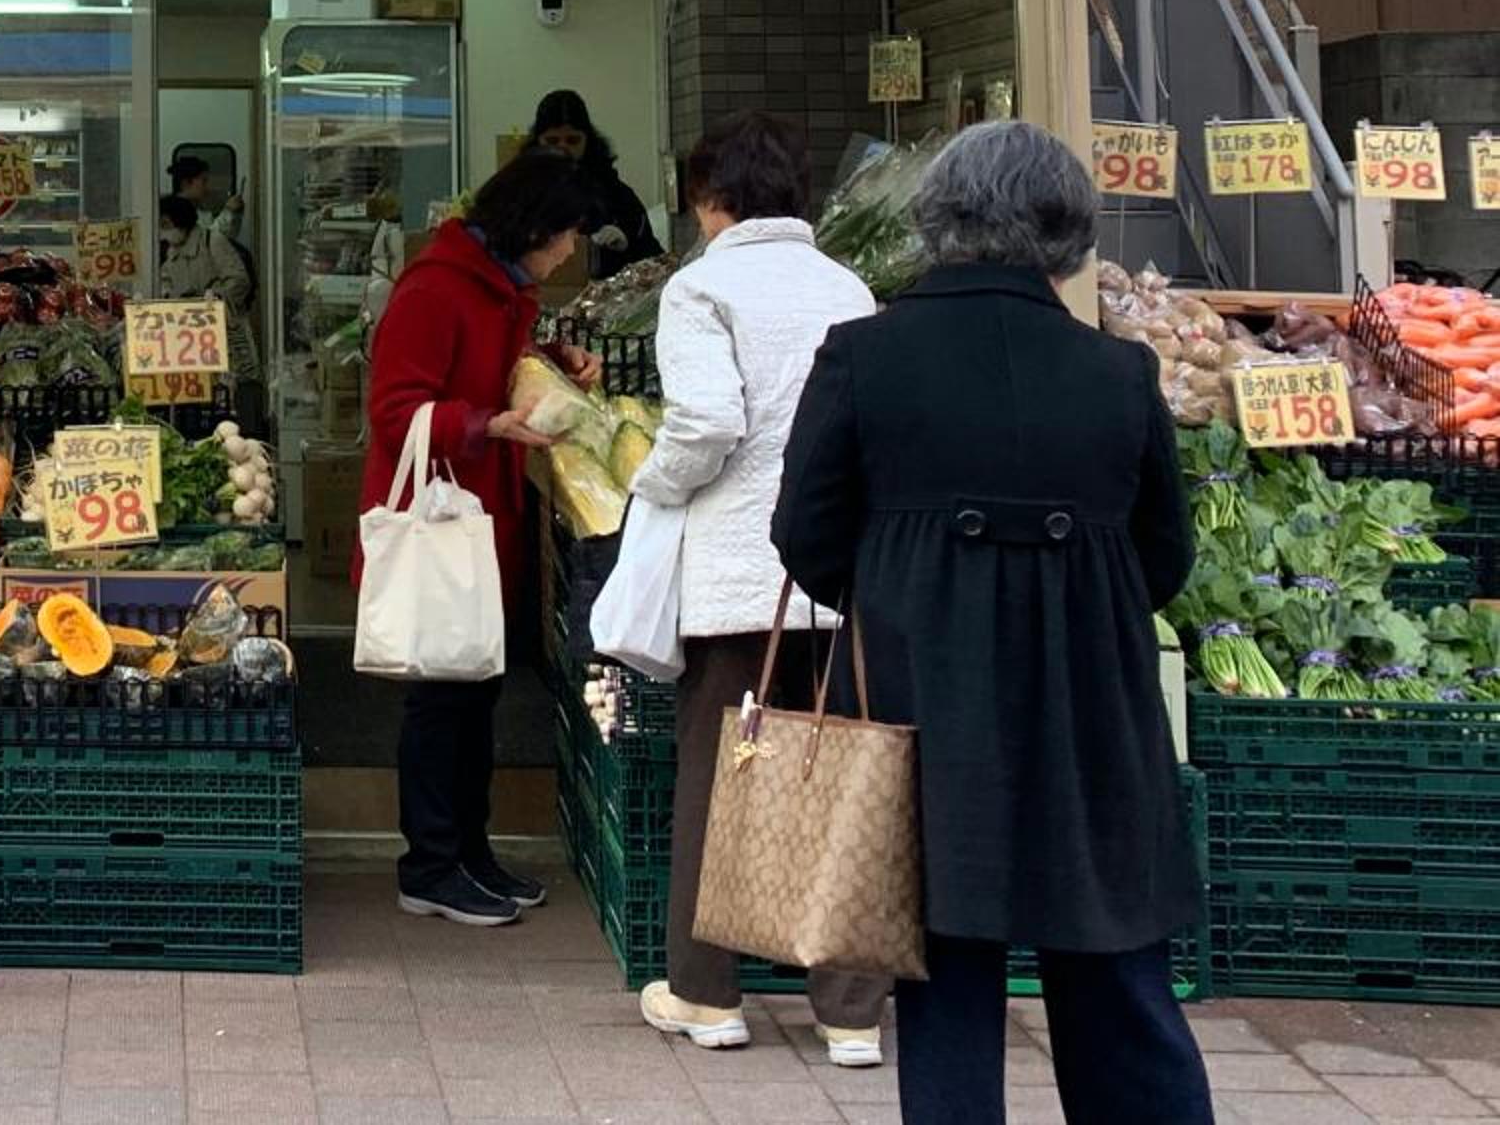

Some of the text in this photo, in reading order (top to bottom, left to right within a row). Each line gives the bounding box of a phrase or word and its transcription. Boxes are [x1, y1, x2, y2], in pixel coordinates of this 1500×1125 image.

[1213, 132, 1299, 152] 紅はるか
[1363, 133, 1435, 154] にんじん
[134, 308, 217, 330] かぶ
[48, 472, 143, 500] かぼちゃ
